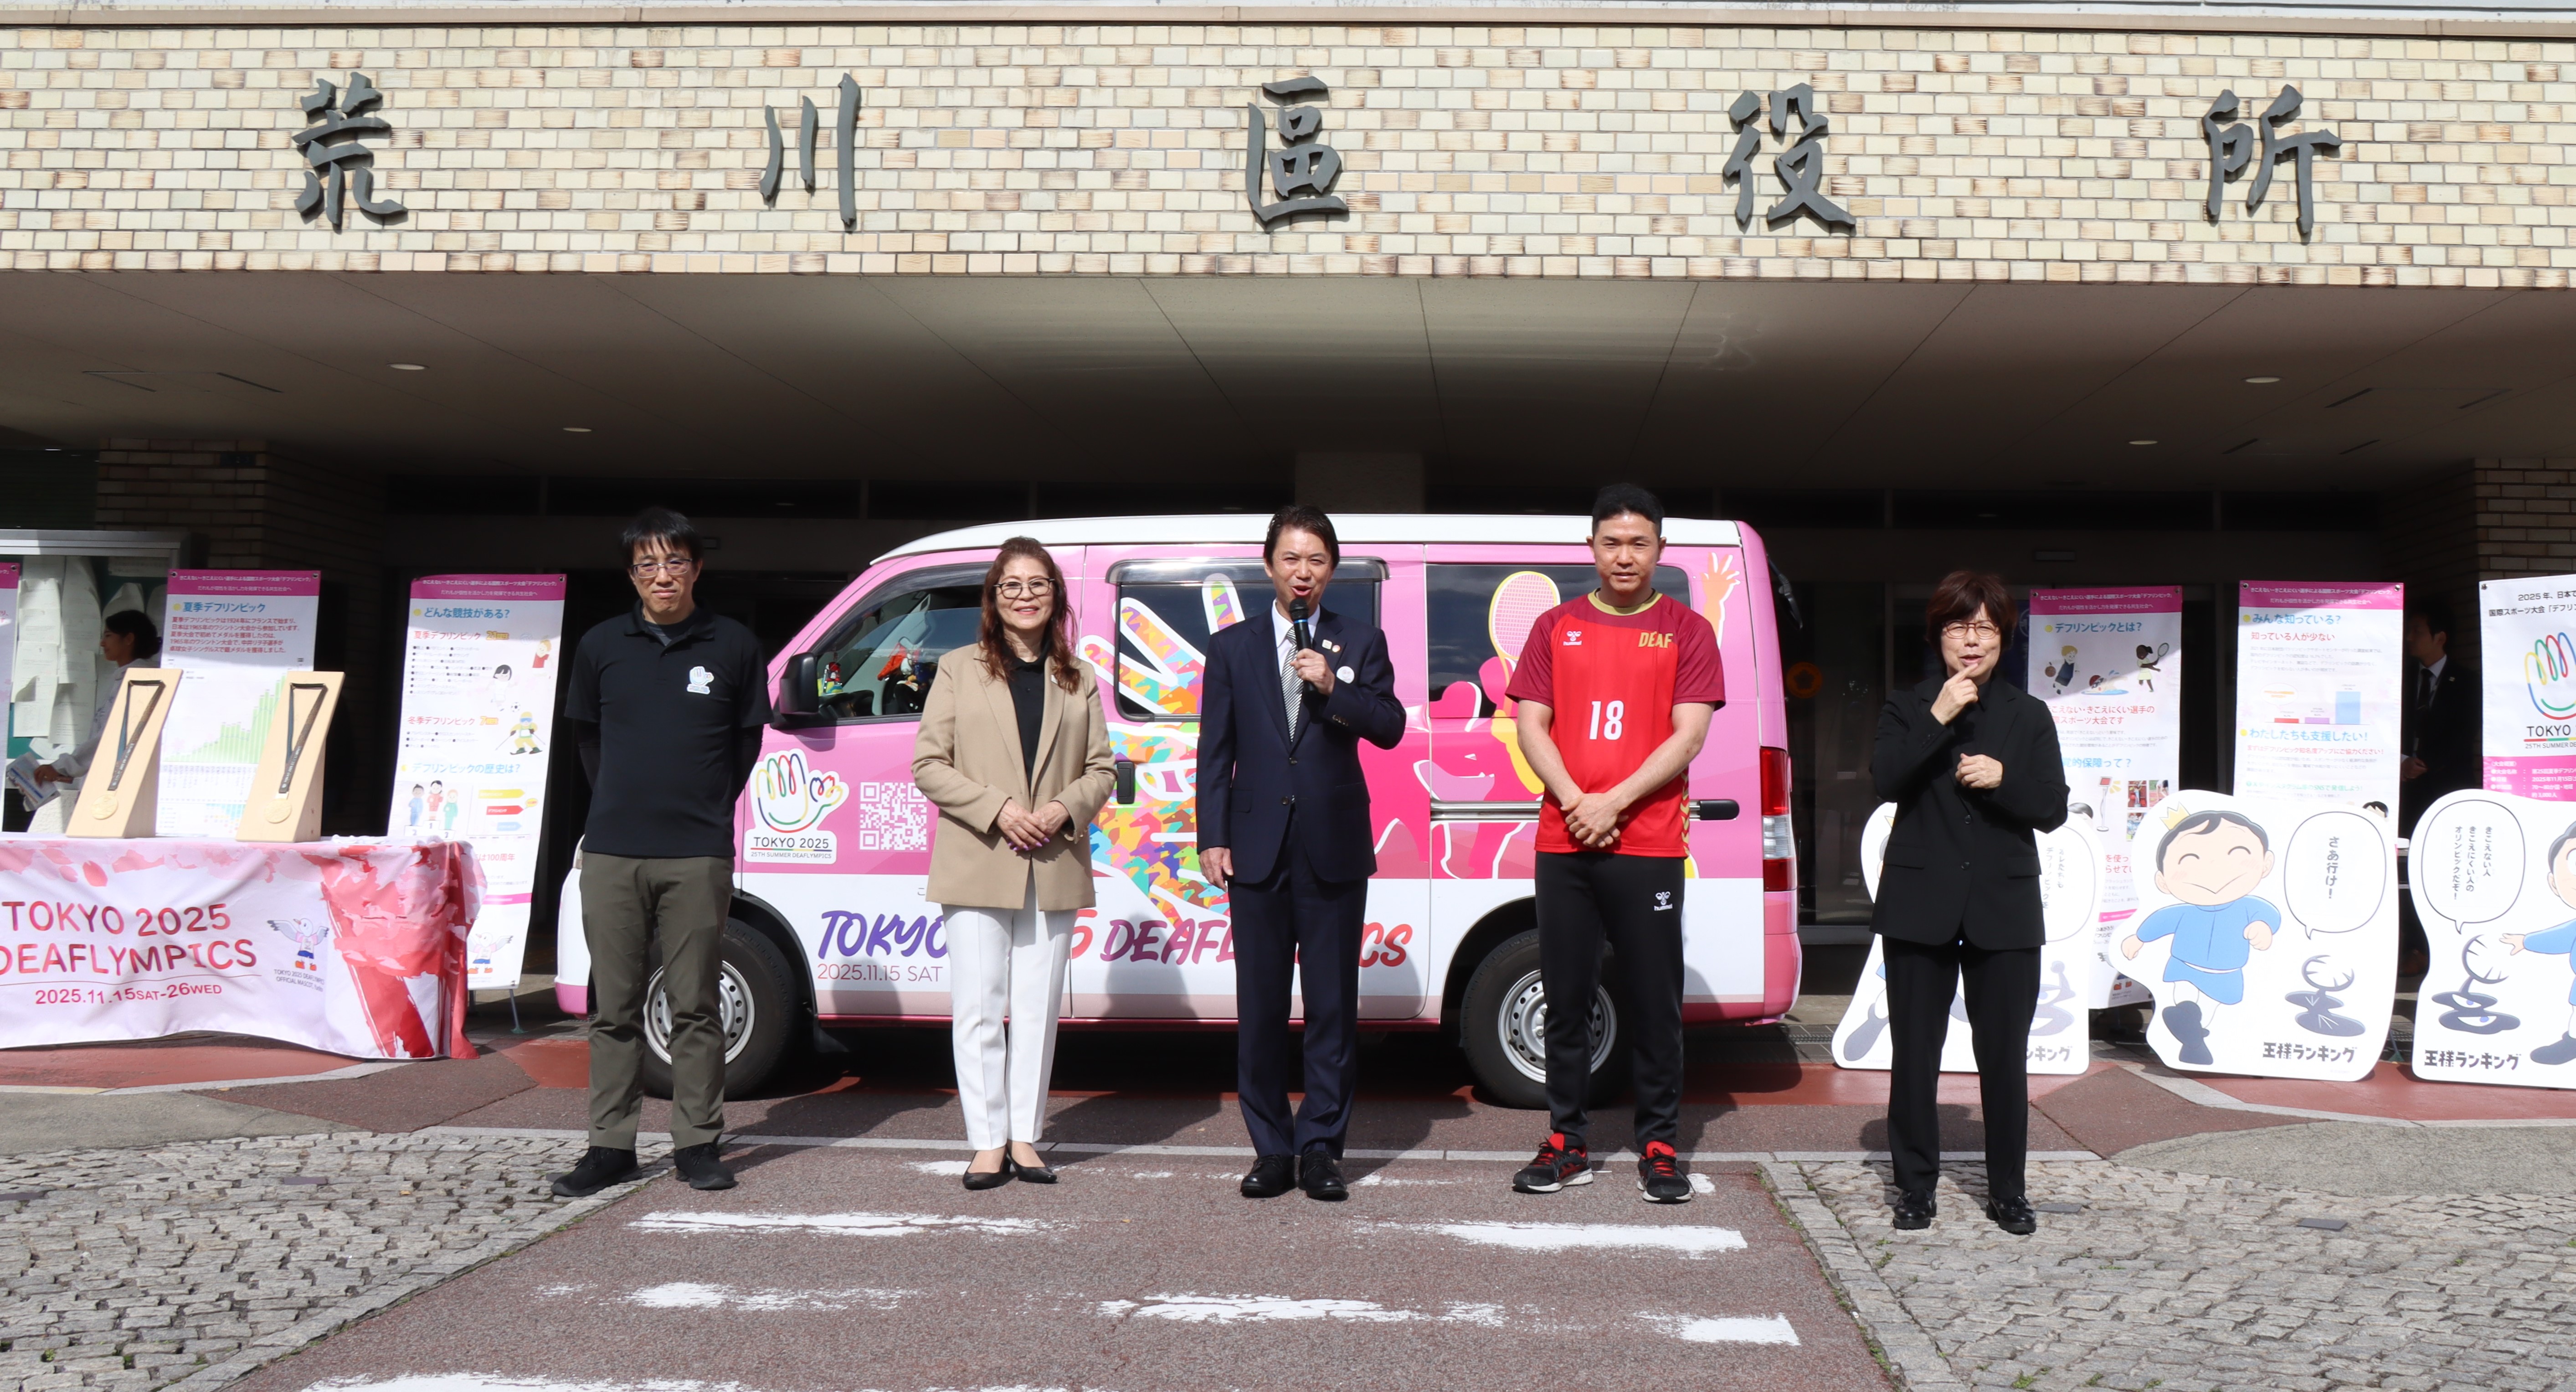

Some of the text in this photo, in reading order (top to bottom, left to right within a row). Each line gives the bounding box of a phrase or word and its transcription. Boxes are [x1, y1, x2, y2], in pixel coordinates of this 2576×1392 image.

[183, 602, 266, 613] 夏季デフリンピック
[2055, 622, 2143, 633] デフリンピックとは？
[2252, 614, 2341, 625] みんな知っている？
[414, 630, 481, 640] 夏季デフリンピック
[1638, 631, 1674, 649] DEAF
[2251, 632, 2336, 641] 知っている人が少ない
[408, 716, 475, 725] 冬季デフリンピック
[1589, 700, 1624, 740] 18
[2526, 725, 2571, 737] TOKYO
[753, 837, 829, 849] TOKYO 2025
[2482, 826, 2493, 877] きこえない人
[2325, 836, 2339, 899] さあ行け！
[2452, 825, 2463, 900] オリンピックだぞ！
[2466, 826, 2477, 892] きこえにくい人の
[2, 901, 231, 937] TOKYO 2025
[818, 910, 949, 960] TOKYO
[276, 976, 297, 985] OFFICIAL
[818, 963, 943, 982] 2025.11.15 SAT
[2262, 1041, 2358, 1063] 王様ランキング
[2424, 1049, 2522, 1071] 王様ランキング
